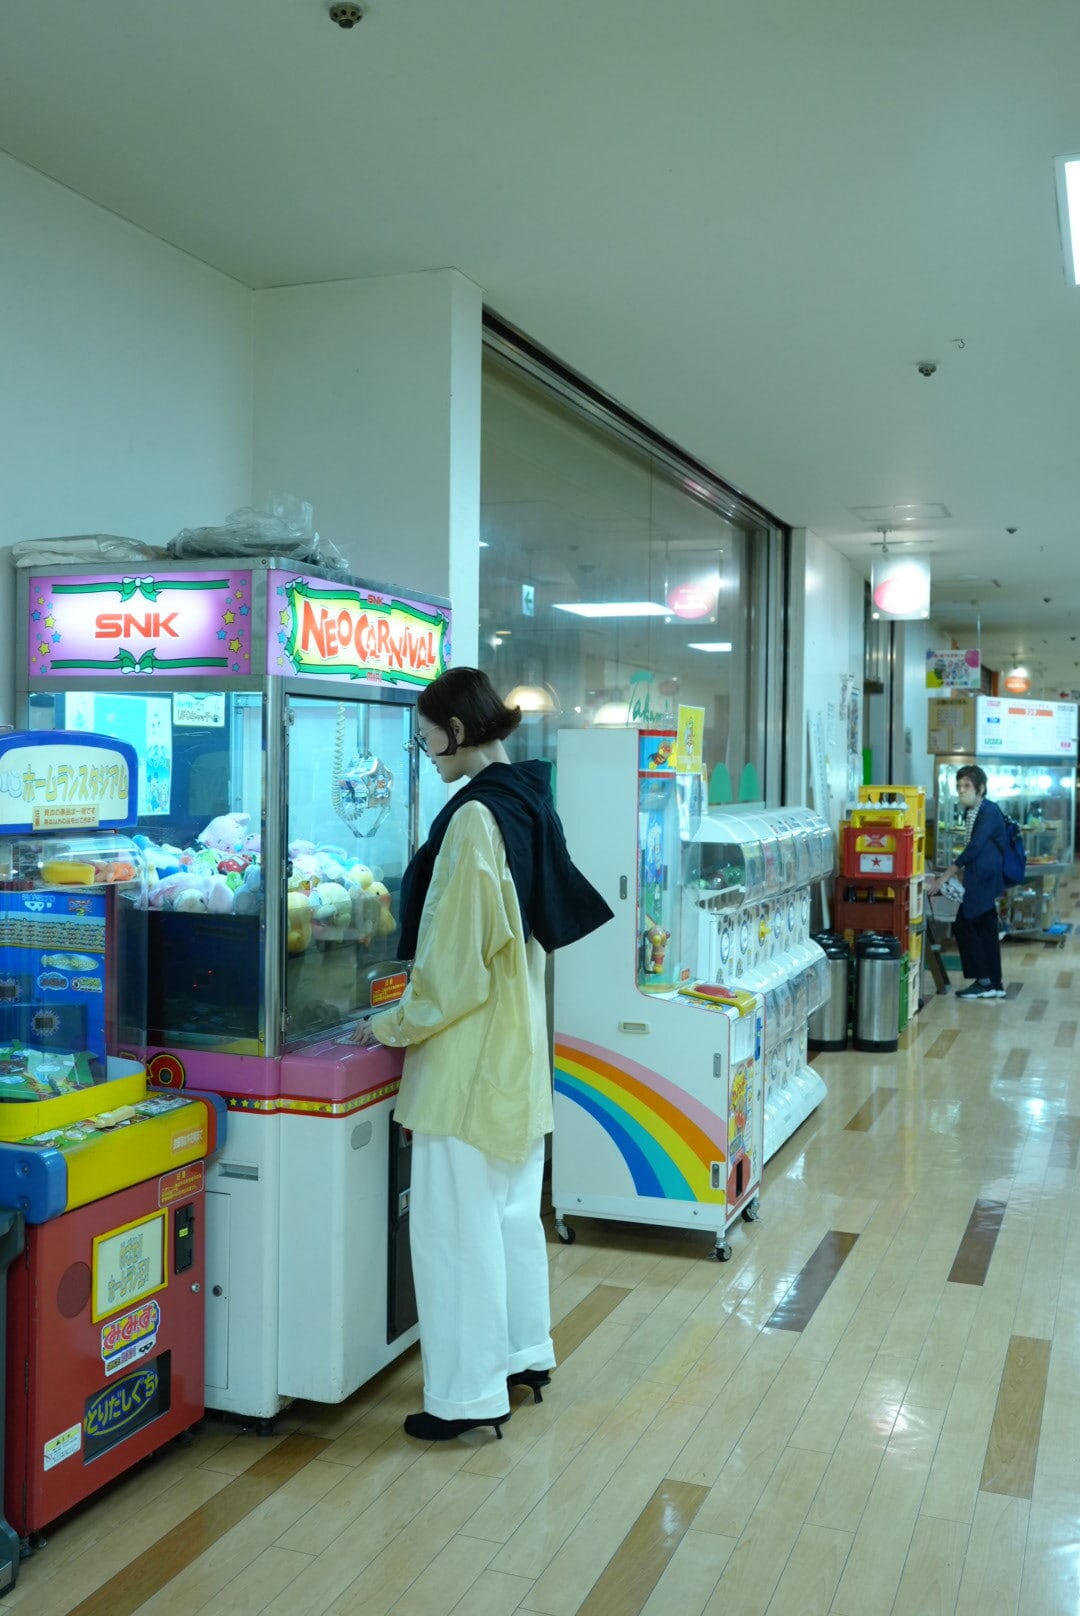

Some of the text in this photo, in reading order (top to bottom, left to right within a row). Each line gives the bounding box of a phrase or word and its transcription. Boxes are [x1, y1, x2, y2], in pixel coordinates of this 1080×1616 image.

[367, 594, 383, 605] SNK
[95, 612, 180, 638] SNK
[301, 600, 436, 669] NEO CARNIVAL
[87, 1373, 155, 1435] とりだしぐち
